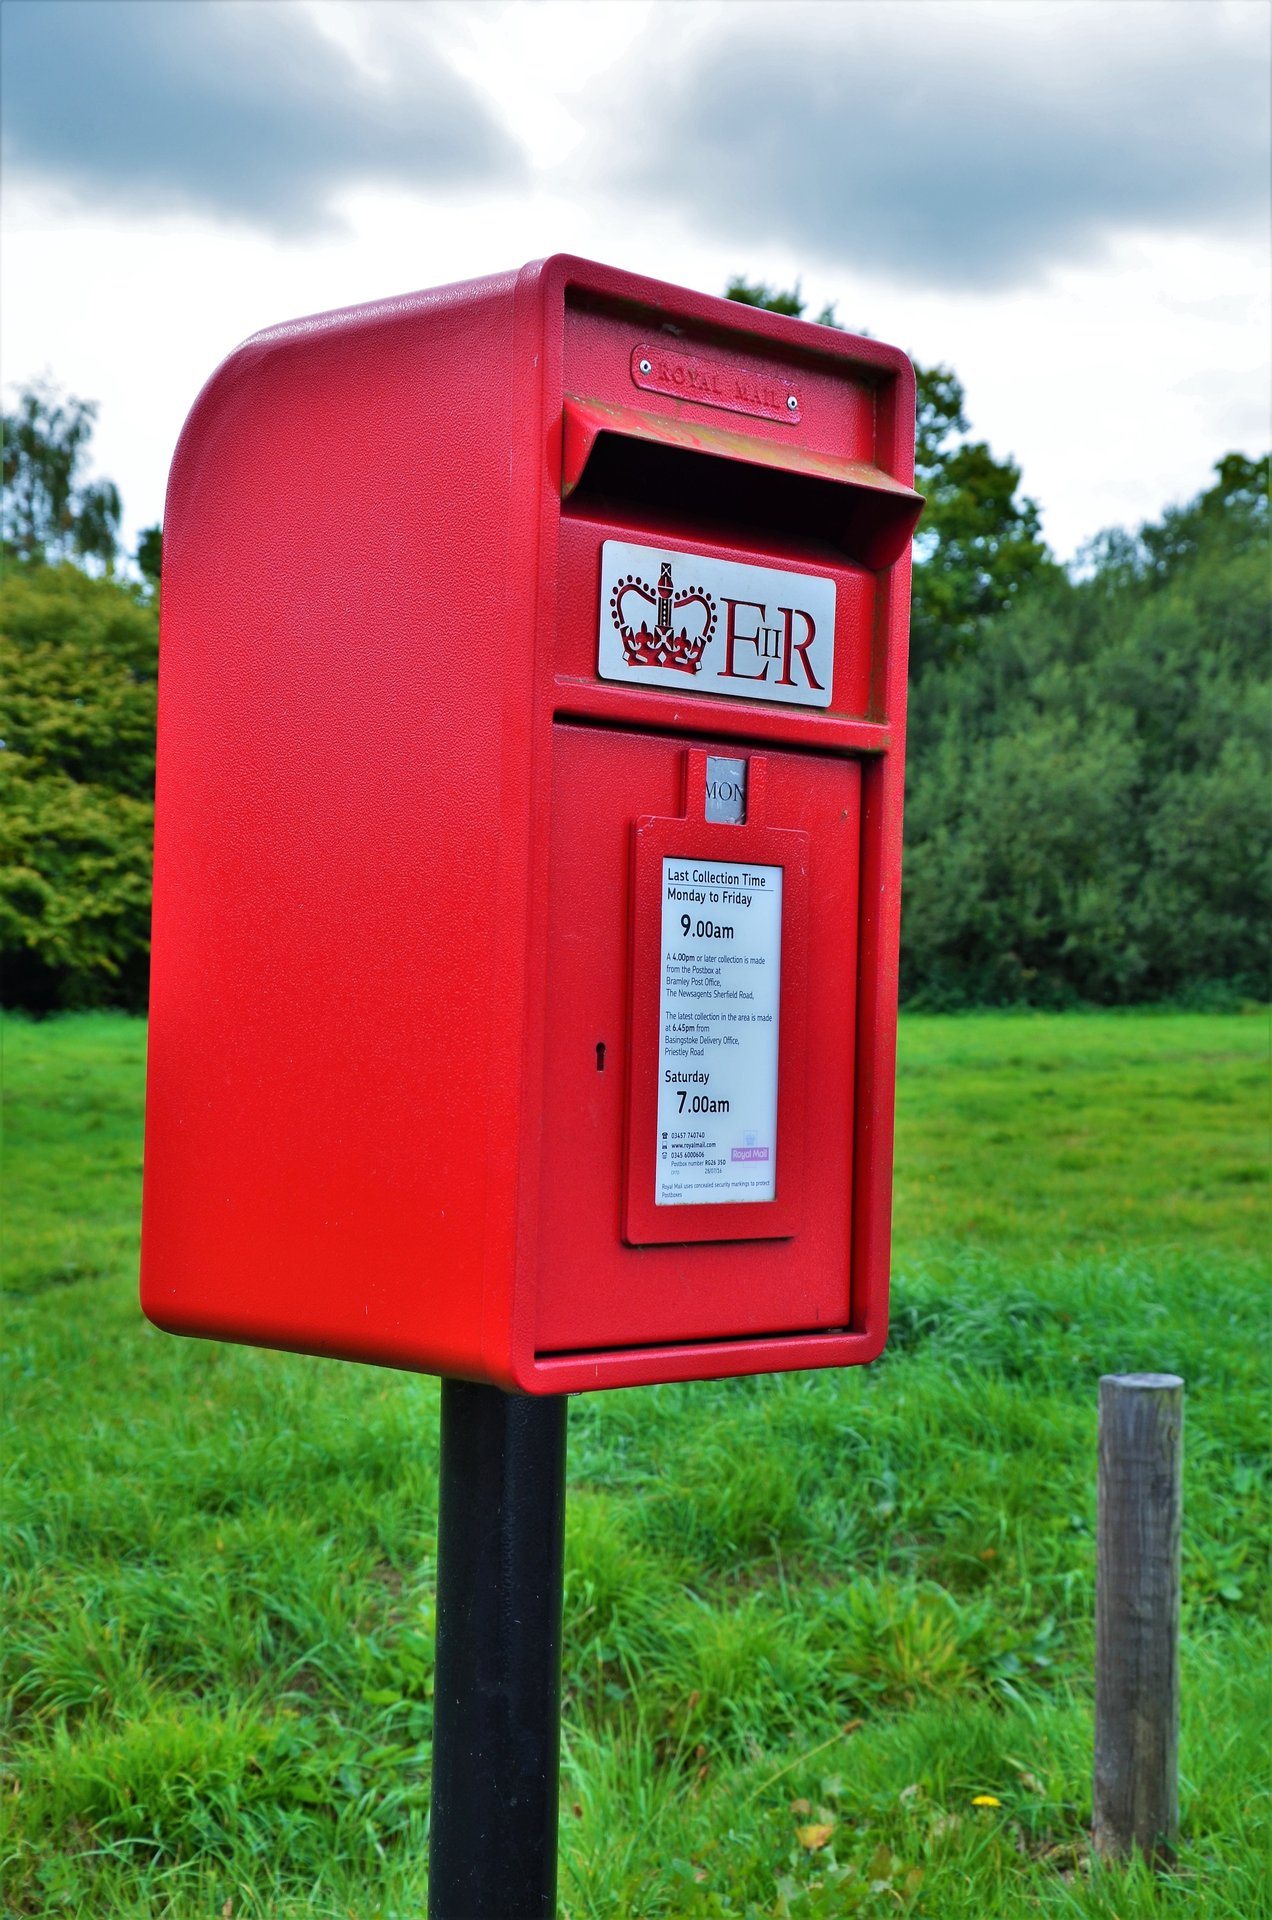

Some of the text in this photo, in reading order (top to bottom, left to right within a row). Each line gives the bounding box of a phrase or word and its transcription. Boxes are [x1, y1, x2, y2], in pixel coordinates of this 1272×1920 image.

[656, 362, 781, 409] ROYAL MAIL
[668, 868, 766, 887] Last Collection Time
[667, 888, 752, 908] Monday to Friday
[680, 914, 734, 939] 9.00am
[666, 952, 672, 960] A
[672, 953, 696, 964] 4.00pm
[704, 954, 717, 962] later
[718, 955, 744, 964] collection
[744, 956, 749, 964] is
[666, 964, 722, 975] from the Postbox at
[666, 977, 722, 988] Bramley Post Office,
[666, 988, 678, 998] The
[678, 989, 712, 1000] Newsagents
[713, 990, 738, 999] Sherfield
[666, 1011, 676, 1020] The
[677, 1012, 692, 1020] latest
[694, 1012, 720, 1021] collection
[721, 1012, 727, 1021] in
[728, 1012, 736, 1021] the
[751, 1013, 756, 1022] is
[756, 1014, 772, 1022] made
[672, 1024, 696, 1034] 6.45pm
[696, 1024, 710, 1032] from
[664, 1036, 740, 1046] Basingstoke Delivery Office,
[664, 1048, 704, 1057] Priestley Road
[665, 1070, 710, 1085] Saturday
[676, 1090, 730, 1114] 7.00am
[671, 1142, 716, 1150] www.royalmail.com
[732, 1148, 768, 1160] Royal Mail
